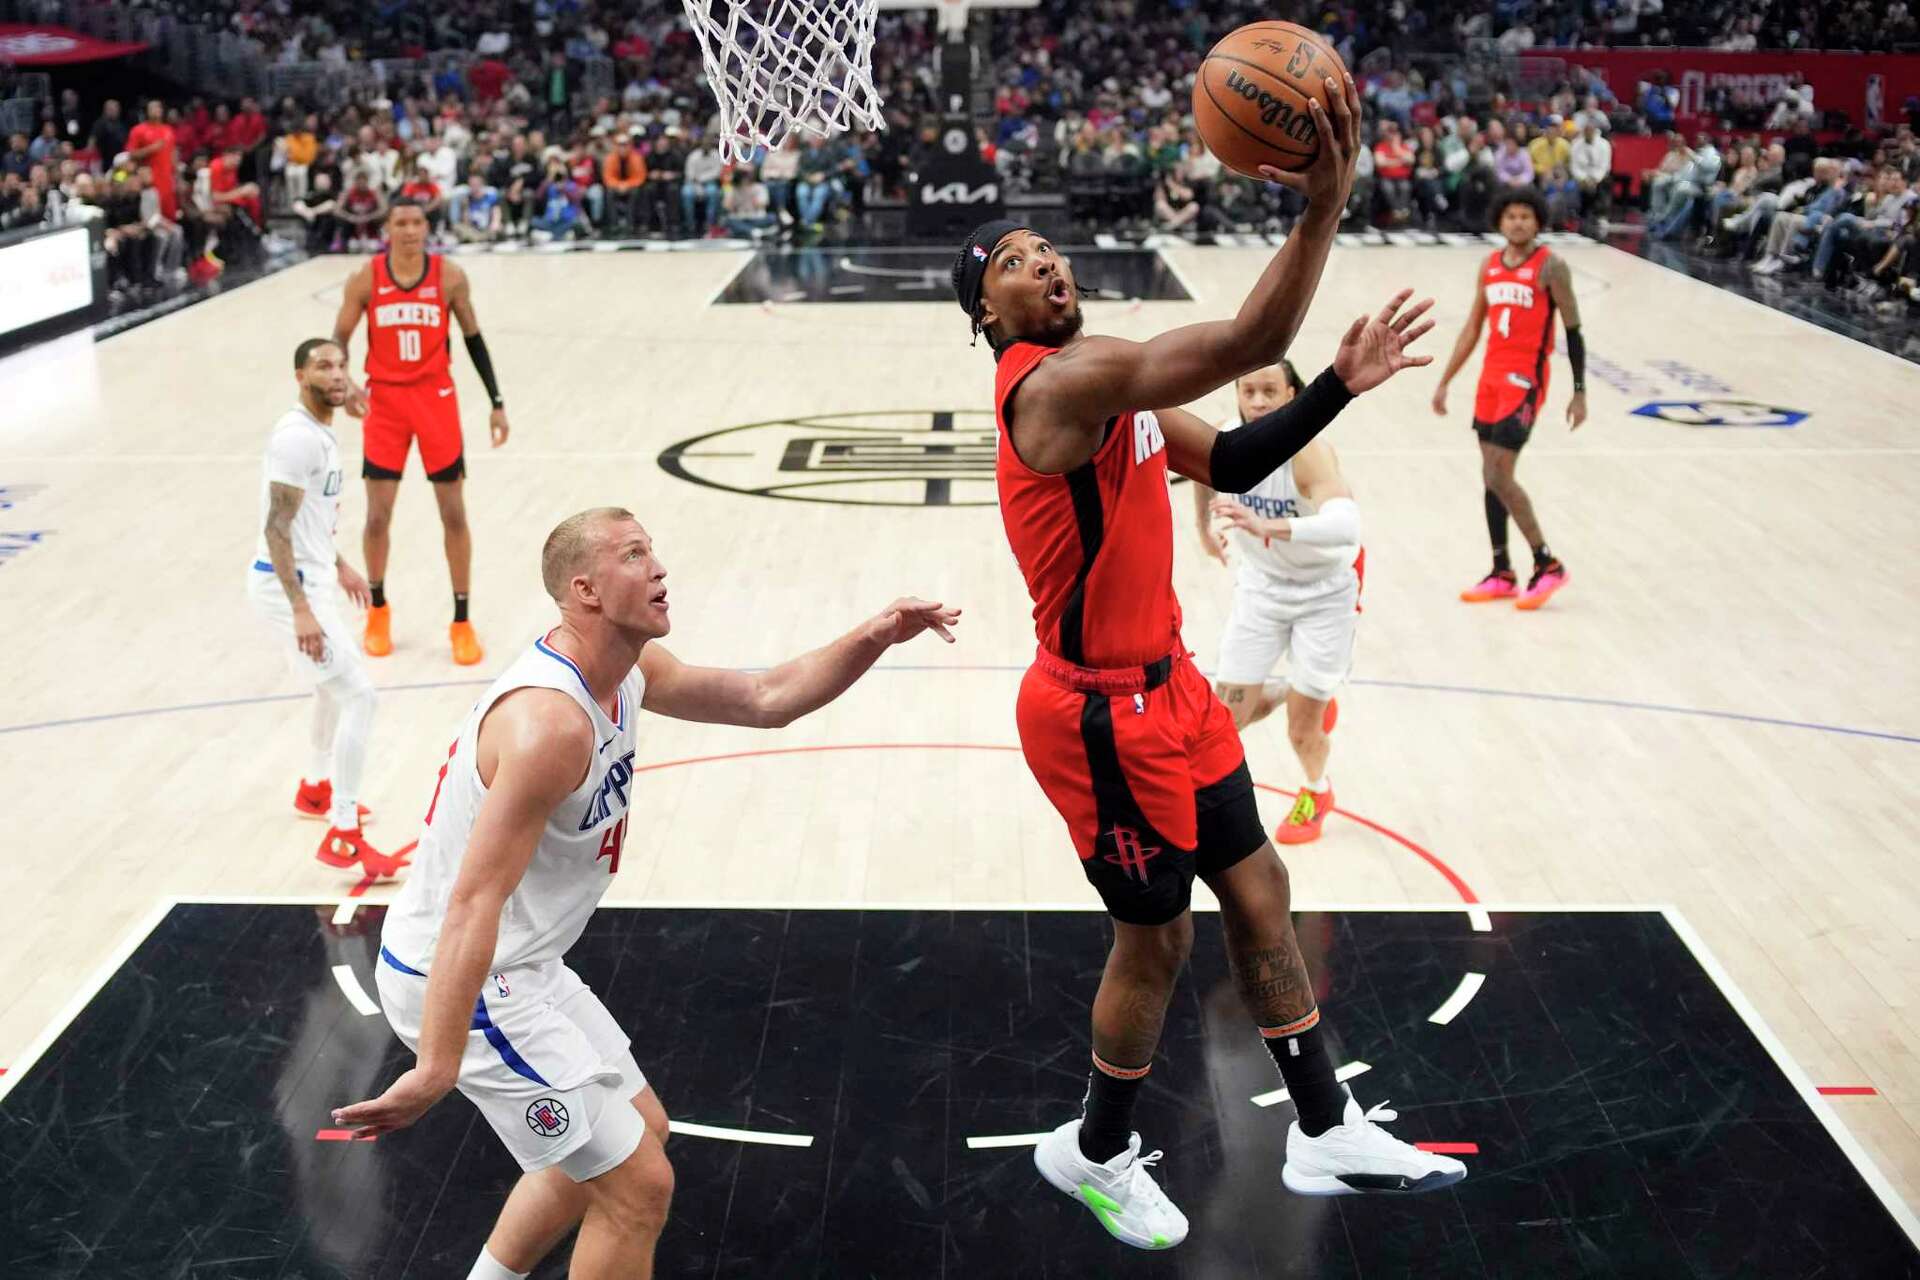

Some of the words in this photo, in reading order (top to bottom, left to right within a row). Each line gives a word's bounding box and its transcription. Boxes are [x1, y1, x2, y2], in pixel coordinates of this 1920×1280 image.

[1226, 69, 1316, 146] Wilson
[1498, 307, 1511, 339] 4
[397, 329, 421, 362] 10
